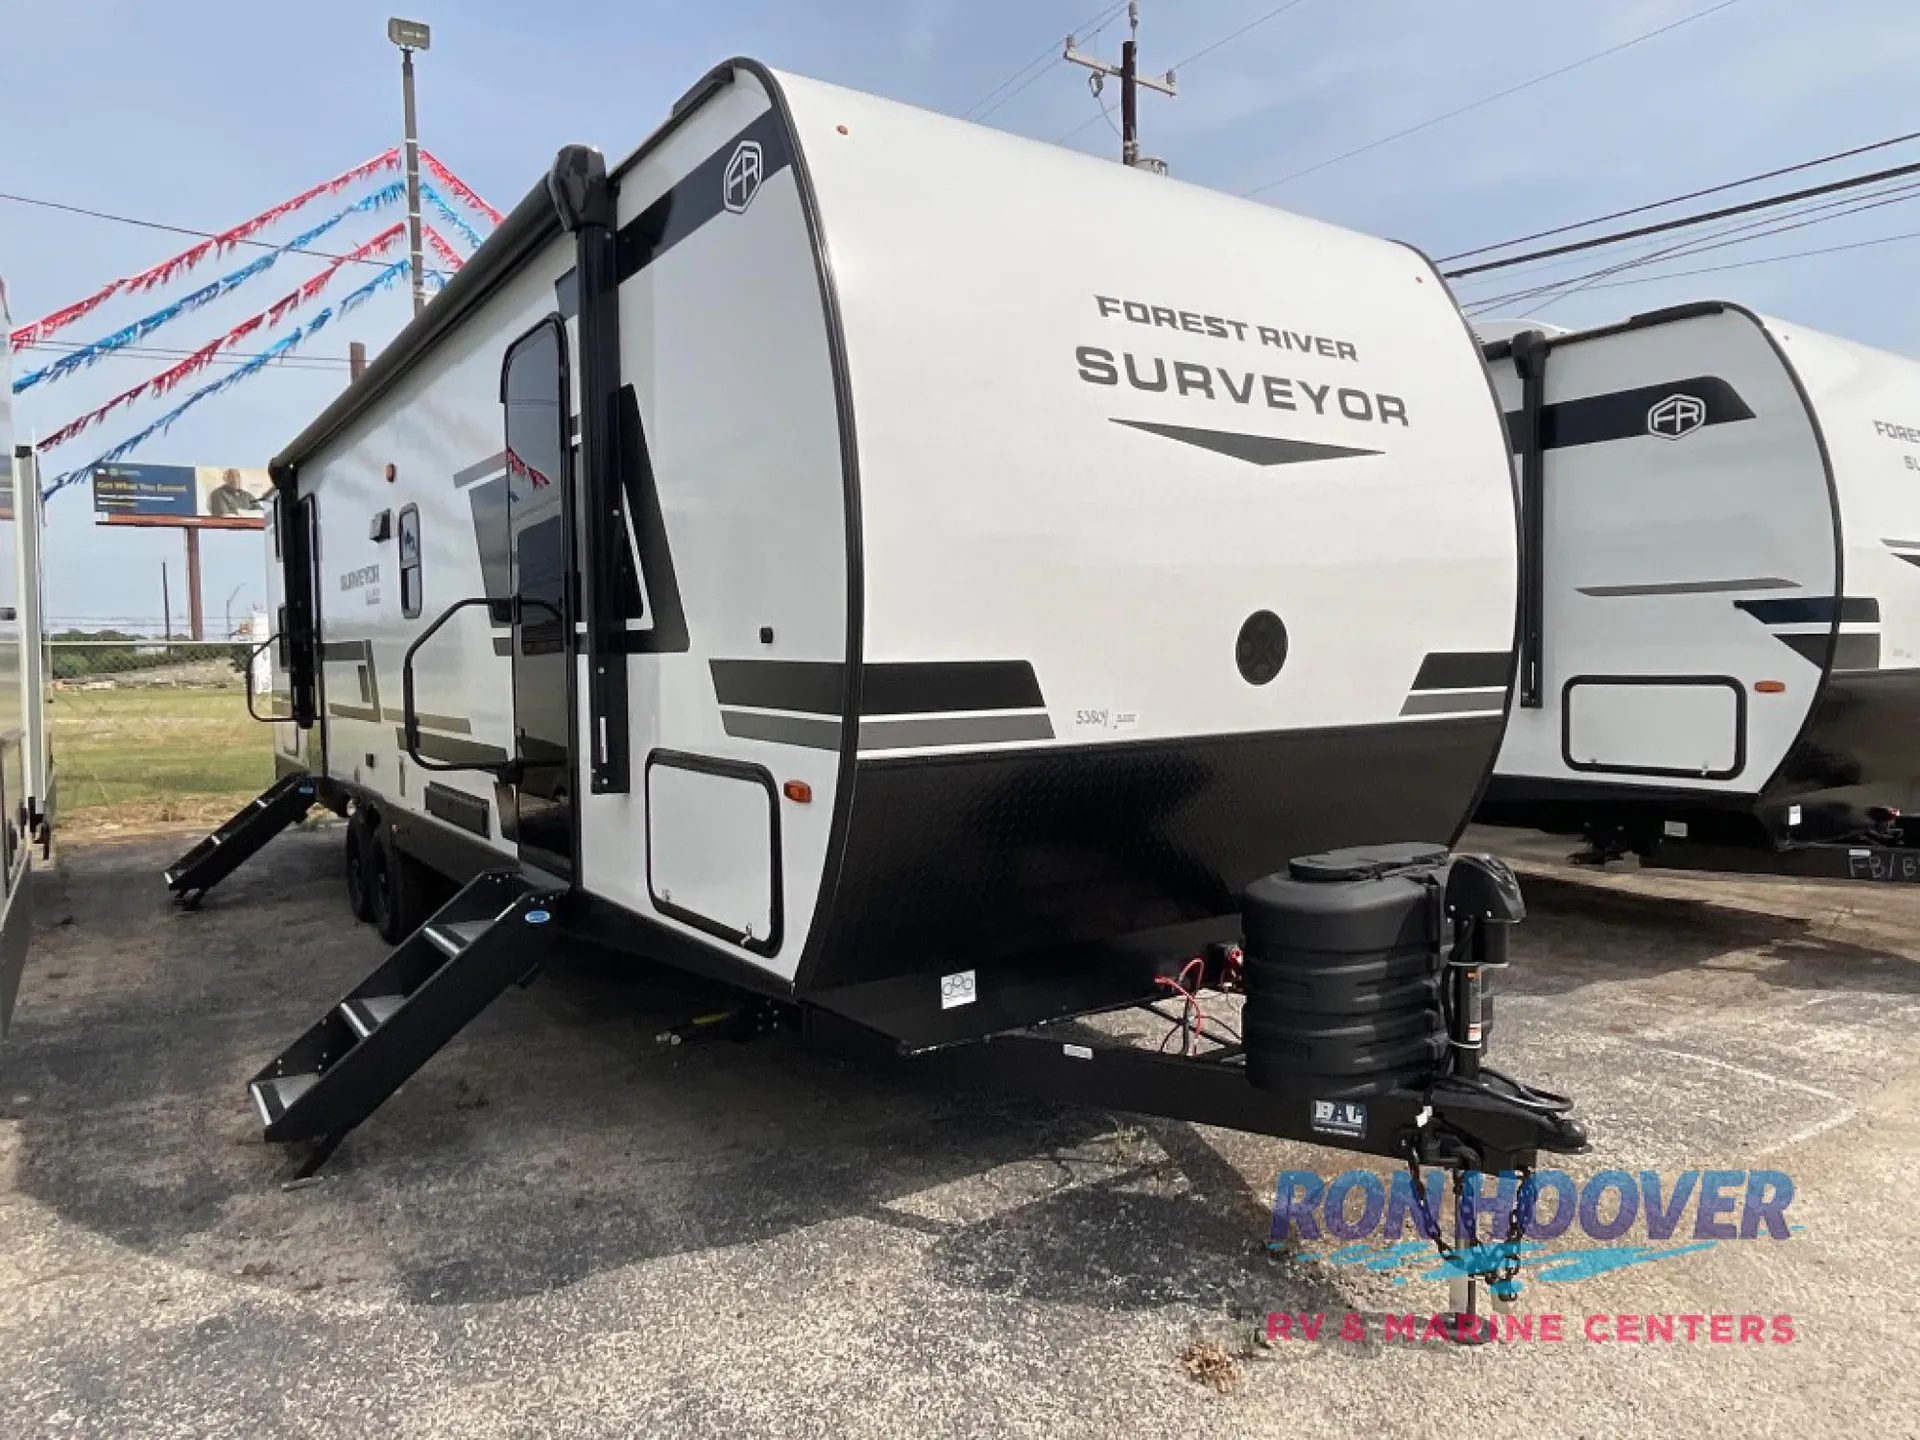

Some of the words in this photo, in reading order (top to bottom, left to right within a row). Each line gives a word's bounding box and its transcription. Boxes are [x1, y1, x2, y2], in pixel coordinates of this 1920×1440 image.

[1094, 294, 1249, 342] FOREST
[1256, 325, 1359, 363] RIVER
[1075, 345, 1410, 427] SURVEYOR
[1872, 419, 1920, 443] FORE
